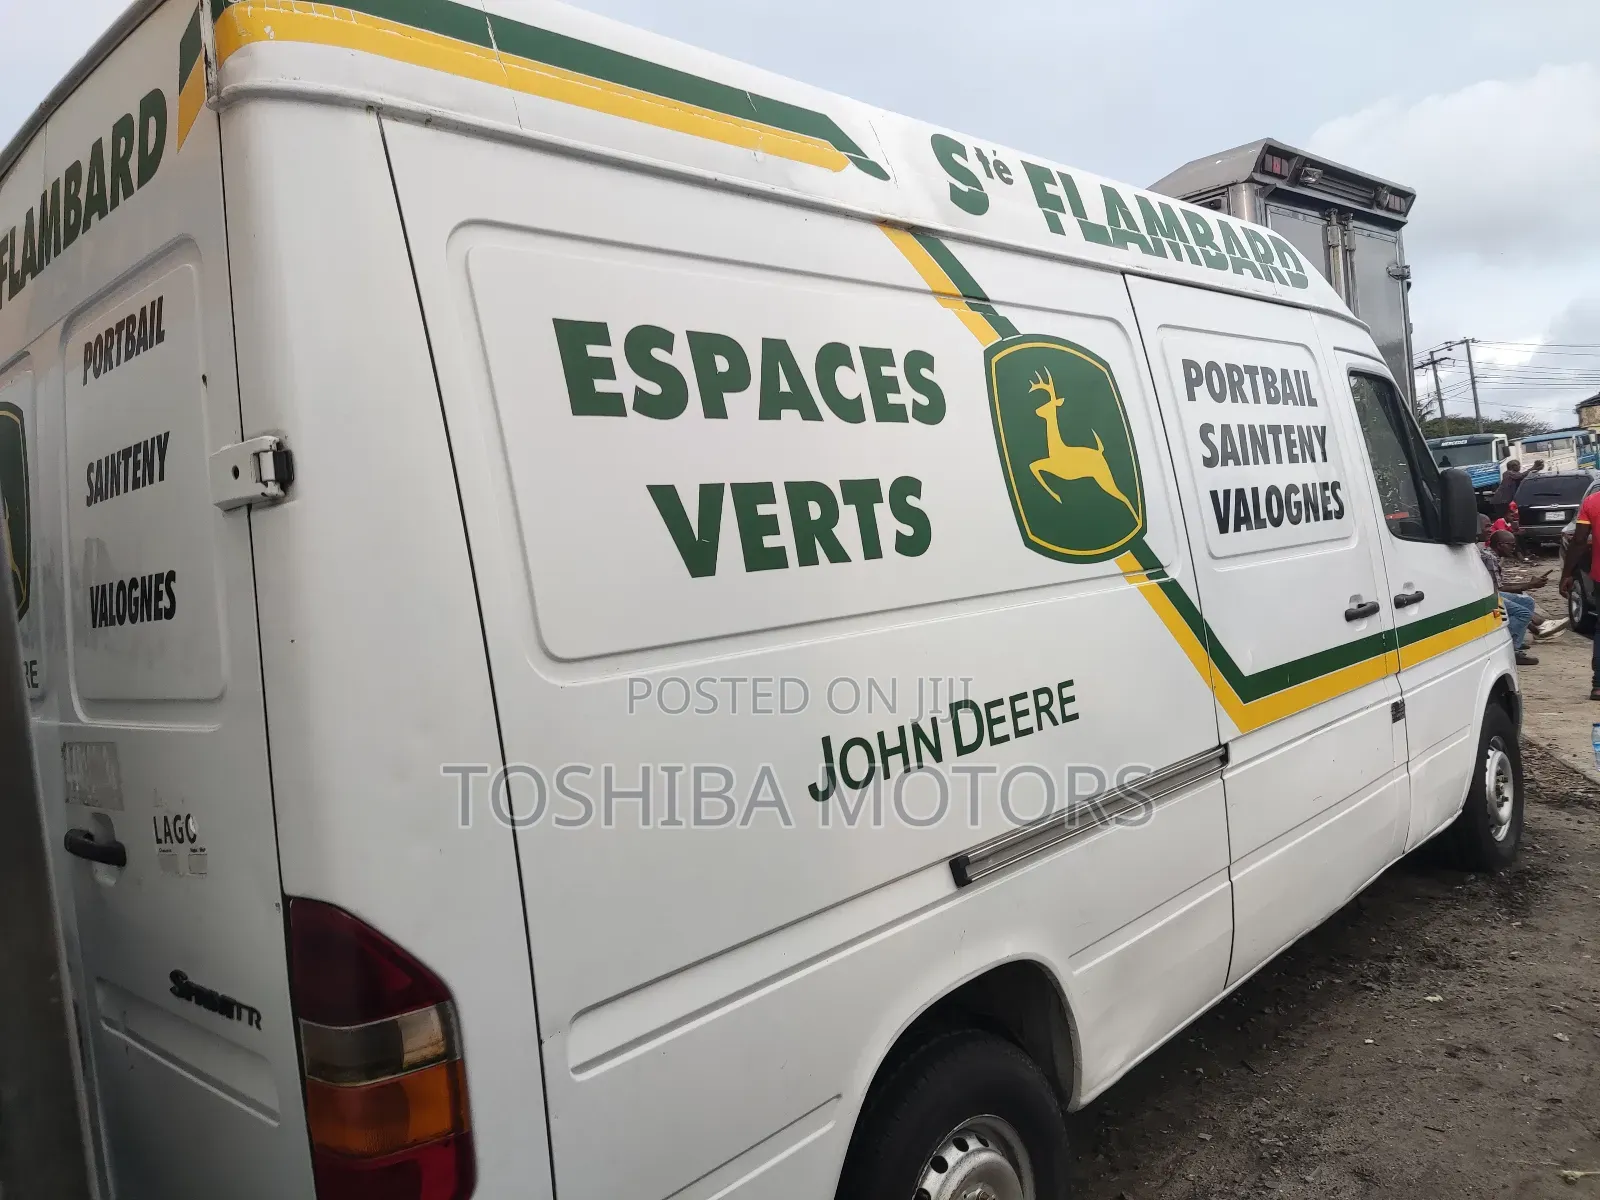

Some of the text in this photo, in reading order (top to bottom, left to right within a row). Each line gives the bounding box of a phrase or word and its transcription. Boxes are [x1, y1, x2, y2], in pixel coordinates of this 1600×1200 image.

[0, 88, 168, 310] FLAMBARD
[1020, 159, 1309, 290] FLAMBARD
[82, 295, 166, 387] PORTBAIL
[552, 317, 947, 426] ESPACES
[1181, 358, 1318, 408] PORTBAIL
[86, 430, 171, 507] SAINTENY
[1199, 422, 1328, 469] SAINTENY
[646, 475, 932, 579] VERTS
[1209, 480, 1345, 535] VALOGNES
[89, 569, 176, 629] VALOGNES
[807, 678, 1080, 803] JOHN DEERE
